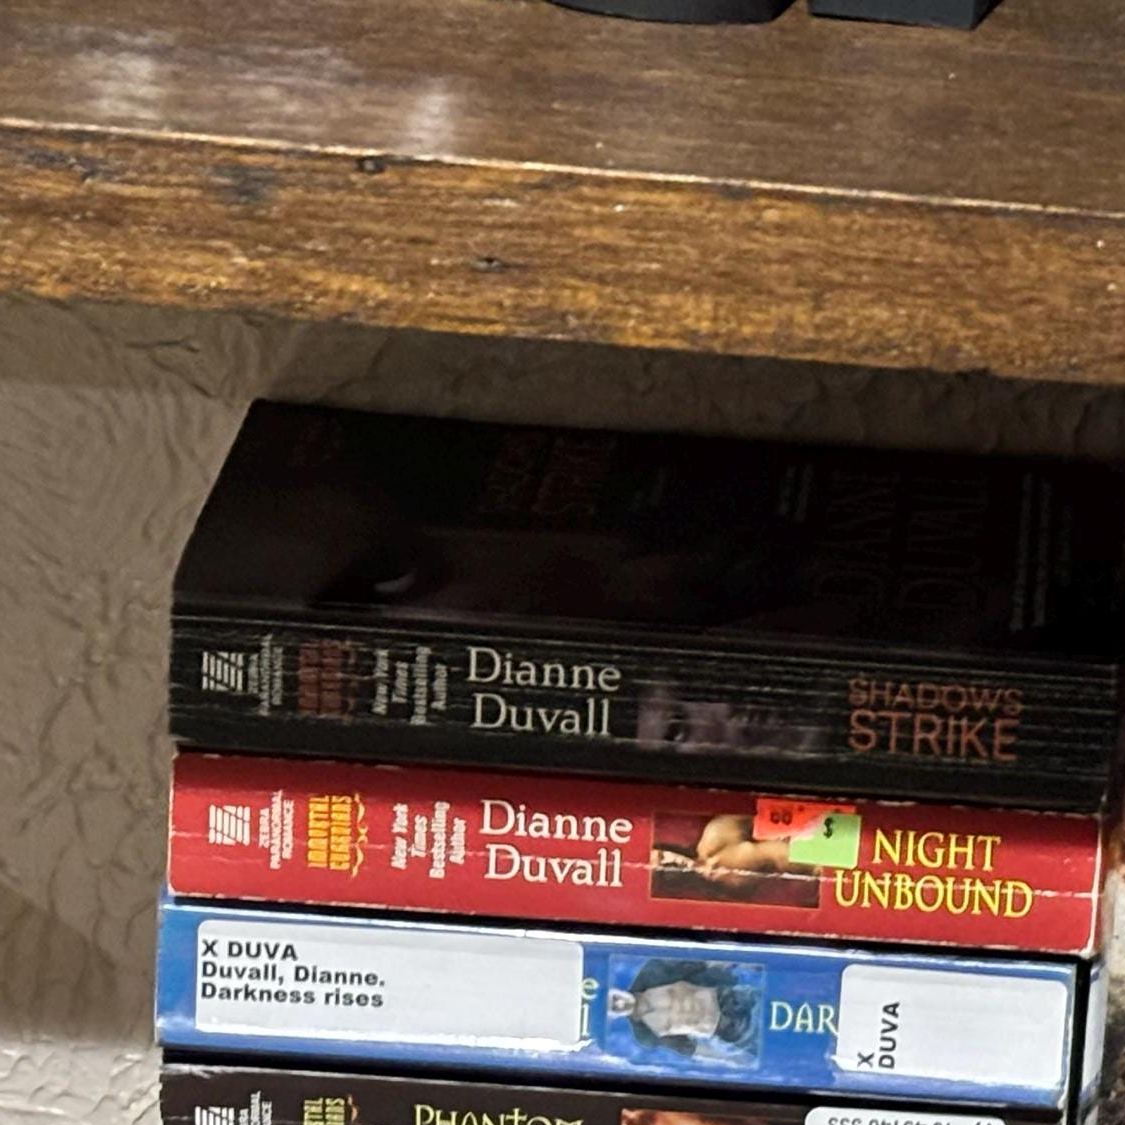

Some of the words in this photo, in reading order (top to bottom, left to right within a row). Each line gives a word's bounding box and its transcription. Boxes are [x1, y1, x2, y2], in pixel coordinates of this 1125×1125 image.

[392, 661, 408, 703] Times
[431, 663, 447, 711] Author
[467, 646, 622, 692] Dianne
[372, 684, 389, 715] New
[471, 692, 611, 737] Duvall
[848, 677, 1024, 716] SHADOWS
[848, 708, 1020, 761] STRIKE
[392, 803, 409, 833] York
[408, 815, 428, 857] Times
[429, 801, 450, 878] Bestselling
[479, 799, 633, 844] Dianne
[391, 837, 408, 870] New
[449, 817, 465, 864] Author
[871, 828, 1002, 872] NIGHT
[484, 843, 623, 888] Duvall
[834, 869, 1034, 919] UNBOUND
[201, 939, 218, 957] X
[228, 941, 299, 962] DUVA
[201, 982, 316, 1005] Darkness
[324, 988, 385, 1009] rises
[202, 961, 285, 985] Duvall,
[294, 965, 386, 987] Dianne.
[769, 1000, 839, 1035] DAR
[878, 1002, 901, 1069] DUVA
[857, 1051, 876, 1069] X
